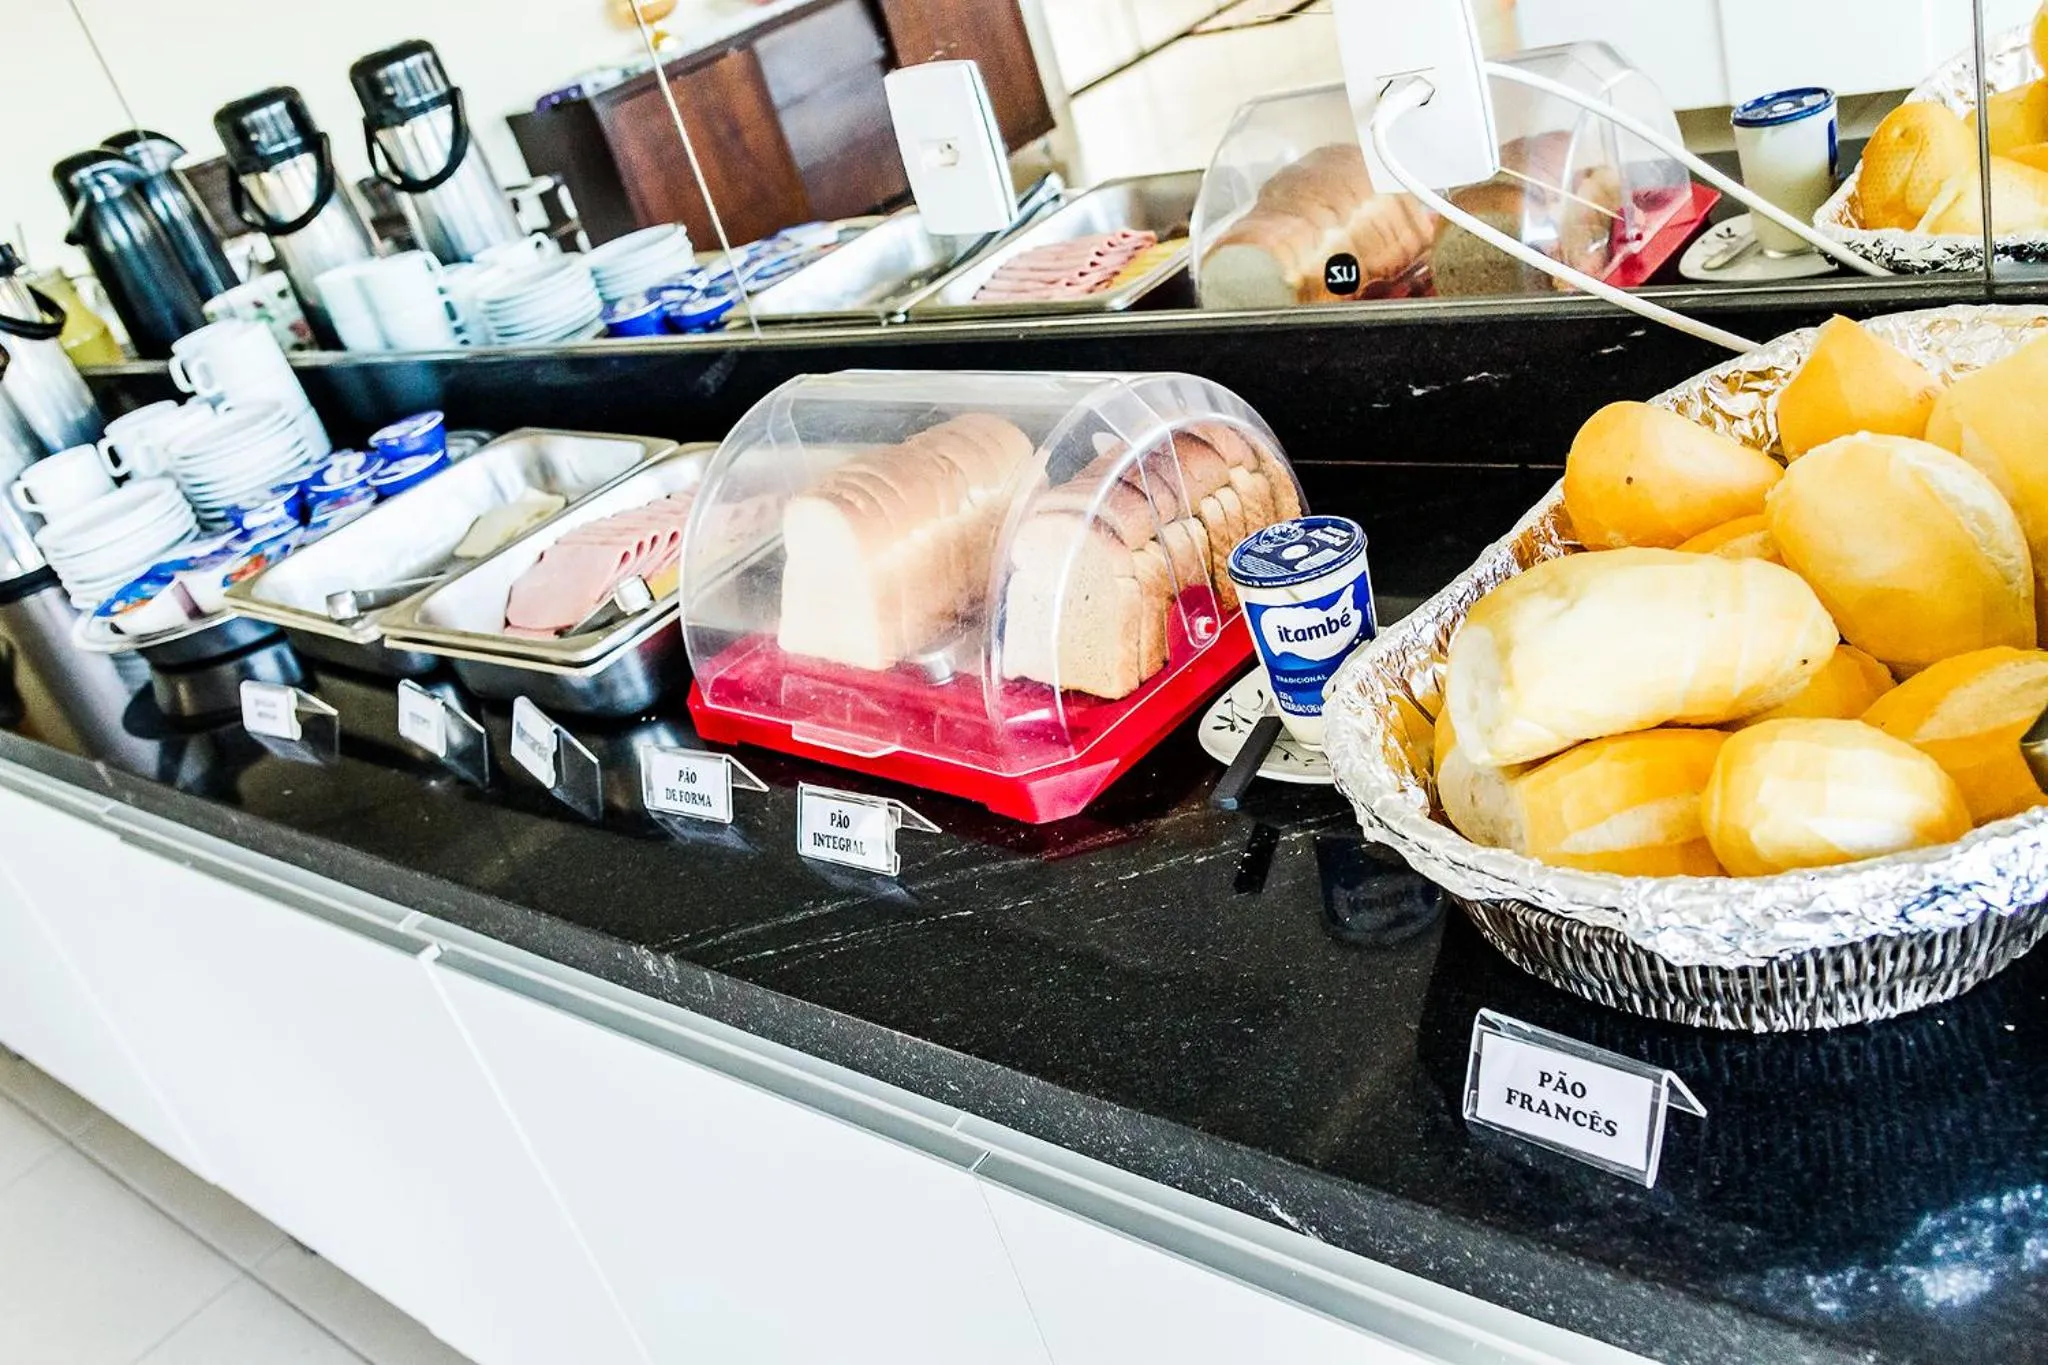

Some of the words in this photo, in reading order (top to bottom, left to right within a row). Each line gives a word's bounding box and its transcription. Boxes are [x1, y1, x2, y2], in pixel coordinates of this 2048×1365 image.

[1277, 606, 1352, 643] itambé
[1275, 674, 1328, 684] TRADICIONAL
[678, 767, 697, 784] PÃO
[665, 787, 678, 802] DE
[679, 790, 712, 807] FORMA
[830, 809, 850, 829] PÃO
[813, 832, 866, 856] INTEGRAL
[1538, 1070, 1587, 1099] PÃO
[1505, 1087, 1618, 1137] FRANCÊS
